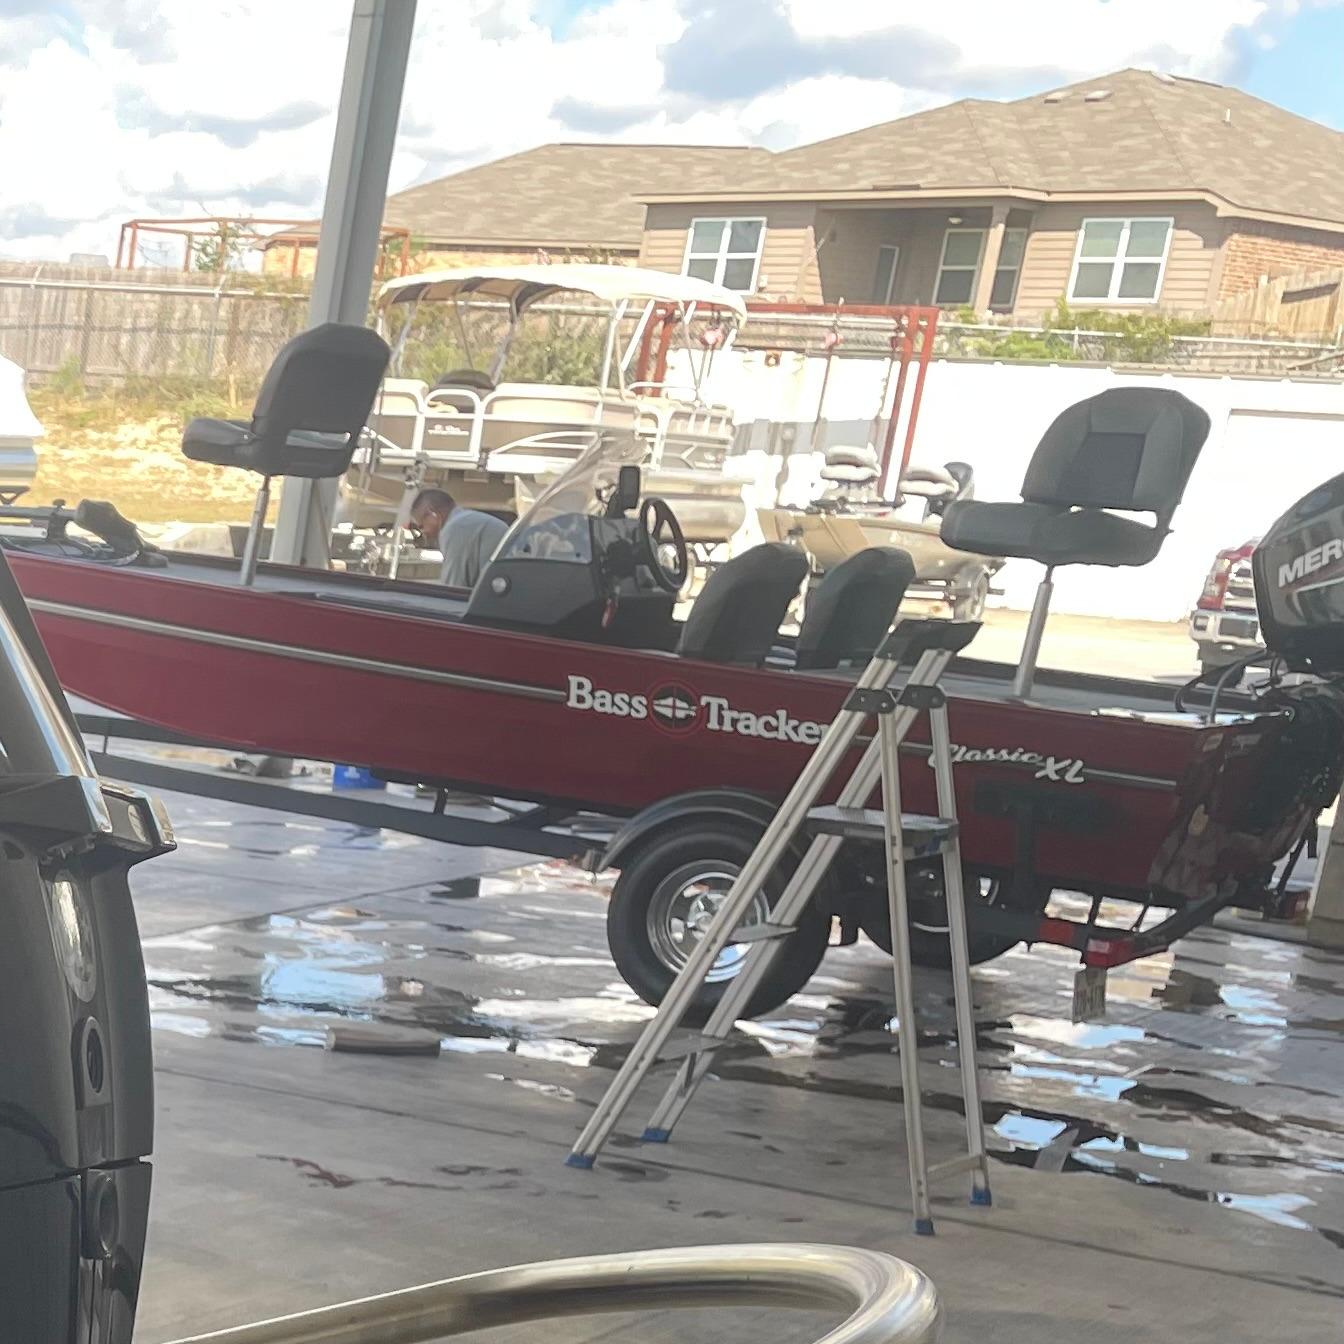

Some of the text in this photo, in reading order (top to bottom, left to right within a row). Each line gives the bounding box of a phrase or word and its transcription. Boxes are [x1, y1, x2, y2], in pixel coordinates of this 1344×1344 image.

[1279, 538, 1344, 588] MER
[567, 675, 648, 719] Bass
[1034, 756, 1085, 783] XL
